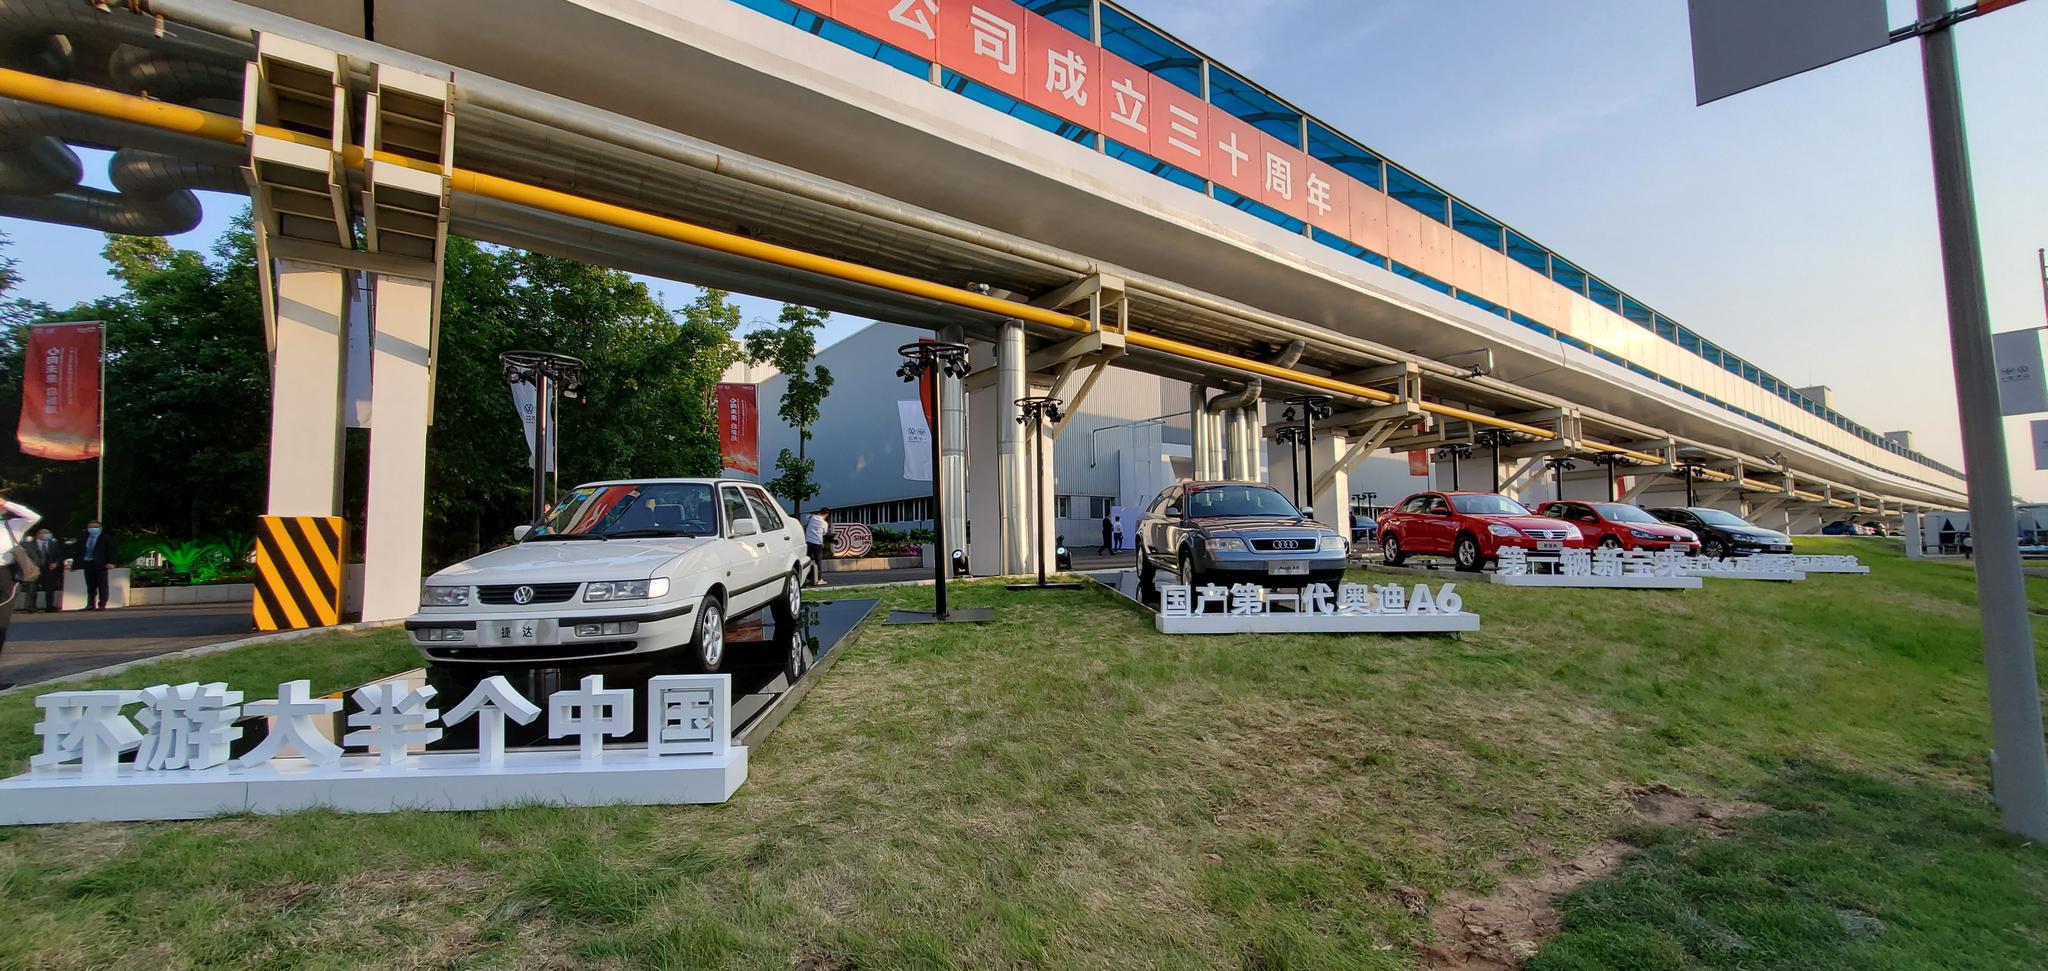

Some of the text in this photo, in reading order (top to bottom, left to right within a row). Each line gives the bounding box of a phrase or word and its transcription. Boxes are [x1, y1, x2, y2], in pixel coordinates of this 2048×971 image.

[888, 0, 1333, 217] 公司成立三十周年
[1496, 546, 1690, 577] 第一辆新宝来
[1159, 582, 1464, 617] 国产第一代奥迪A6
[29, 673, 732, 774] 环游大半个中国
